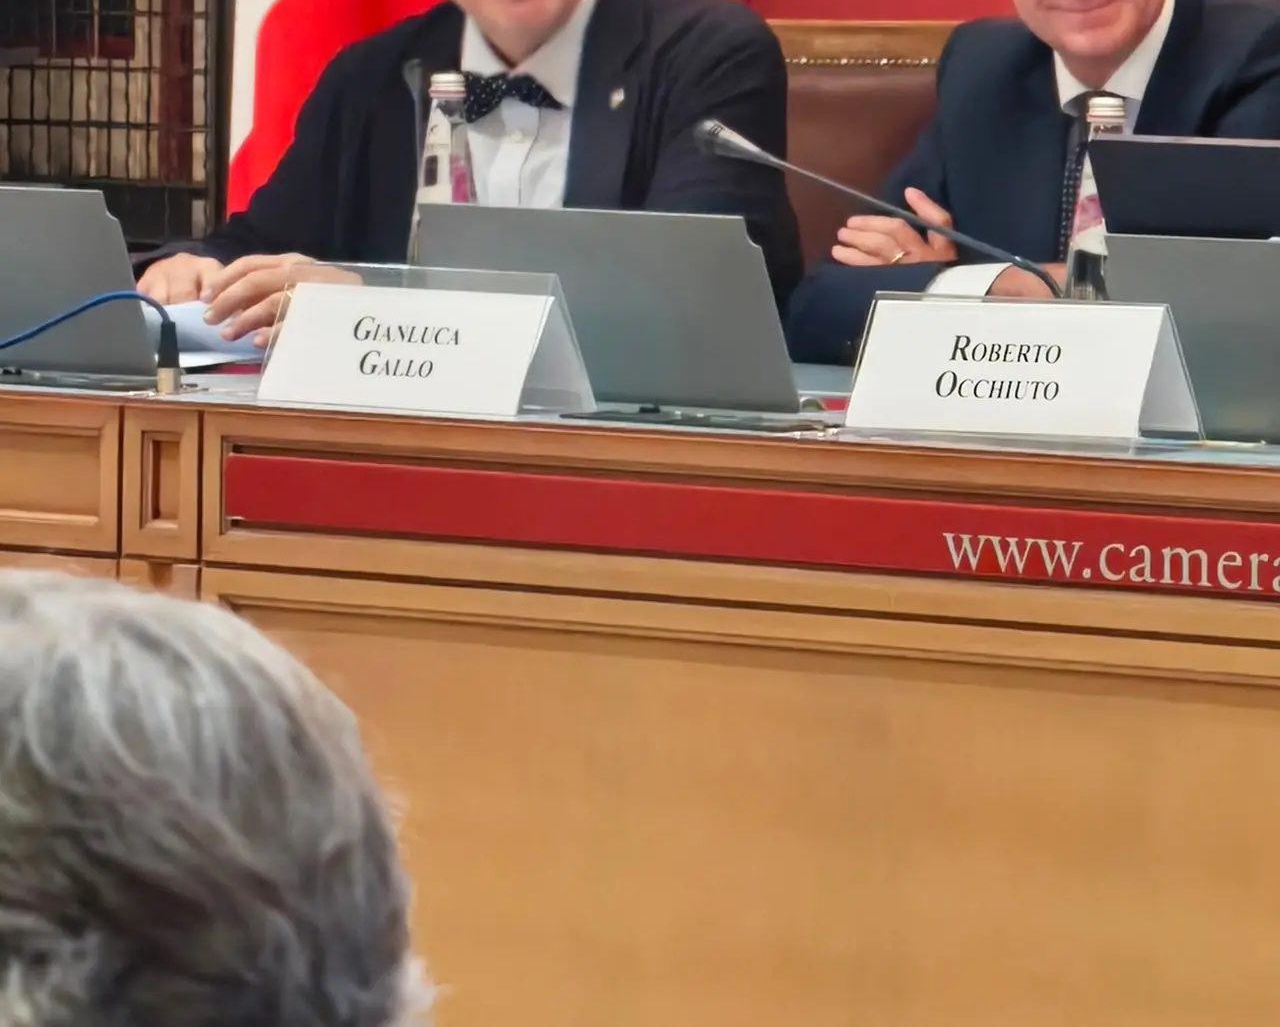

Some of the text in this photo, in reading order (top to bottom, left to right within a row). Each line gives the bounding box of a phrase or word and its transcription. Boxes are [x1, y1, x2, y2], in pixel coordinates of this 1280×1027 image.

[352, 315, 460, 347] GIANLUCA
[358, 349, 435, 379] GALLO
[948, 334, 1063, 365] ROBERTO
[934, 370, 1061, 402] OCCHIUTO
